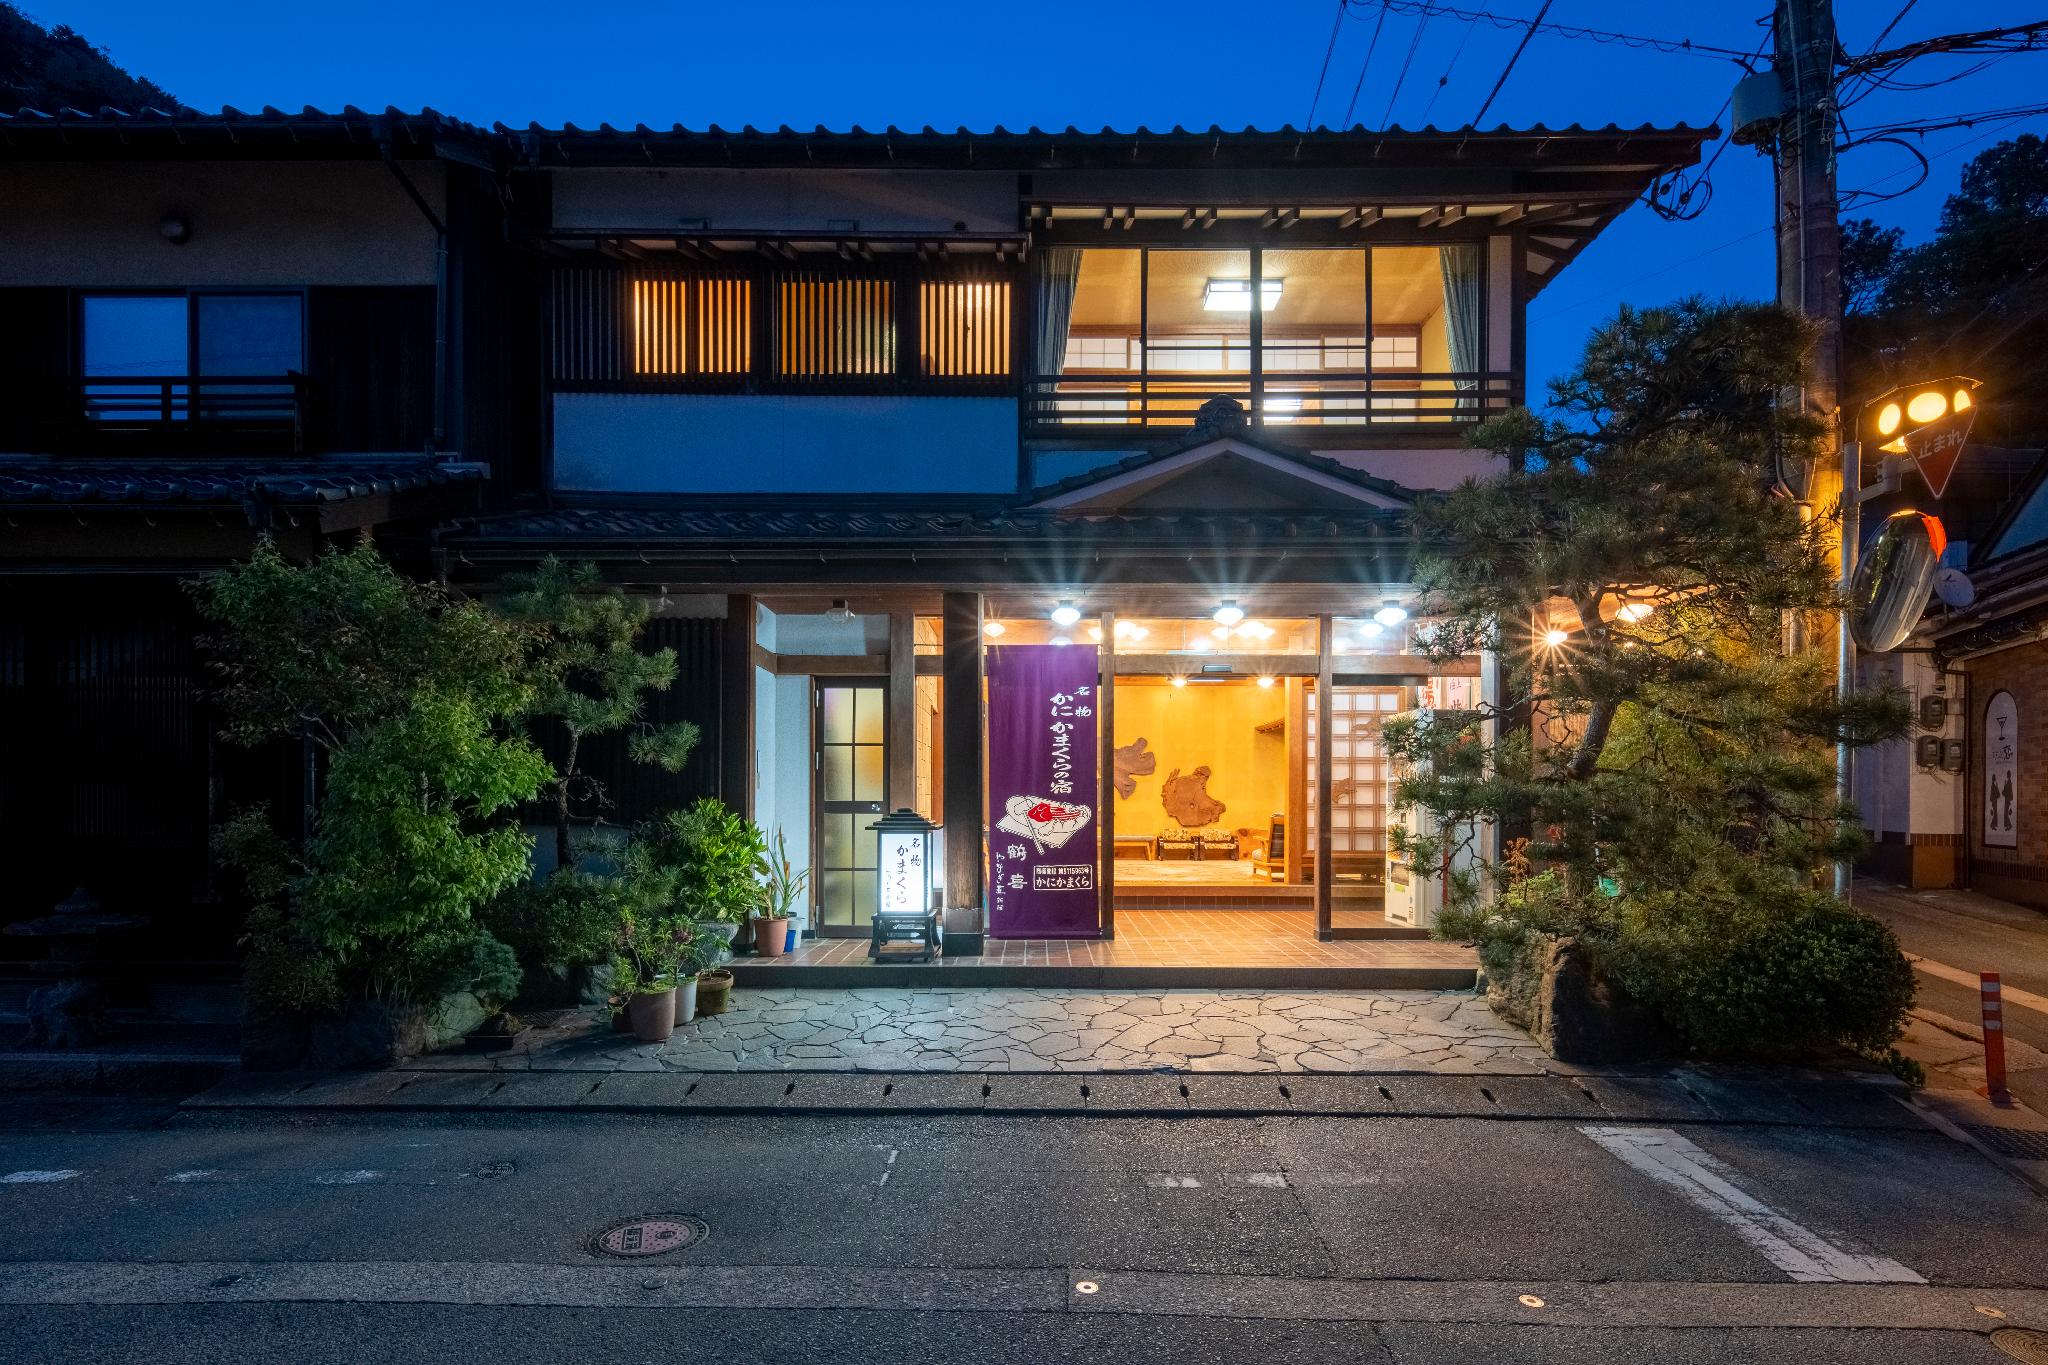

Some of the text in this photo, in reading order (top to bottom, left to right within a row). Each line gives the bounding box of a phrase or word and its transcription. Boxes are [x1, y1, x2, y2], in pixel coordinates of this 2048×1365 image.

[1918, 429, 1962, 460] 止まれ
[1073, 686, 1092, 717] 名物
[1050, 692, 1074, 794] かにかまくらの宿
[910, 837, 922, 867] 名物
[1007, 843, 1028, 889] 鶴喜
[896, 844, 909, 904] かまくら
[1036, 876, 1090, 888] かにかまくら
